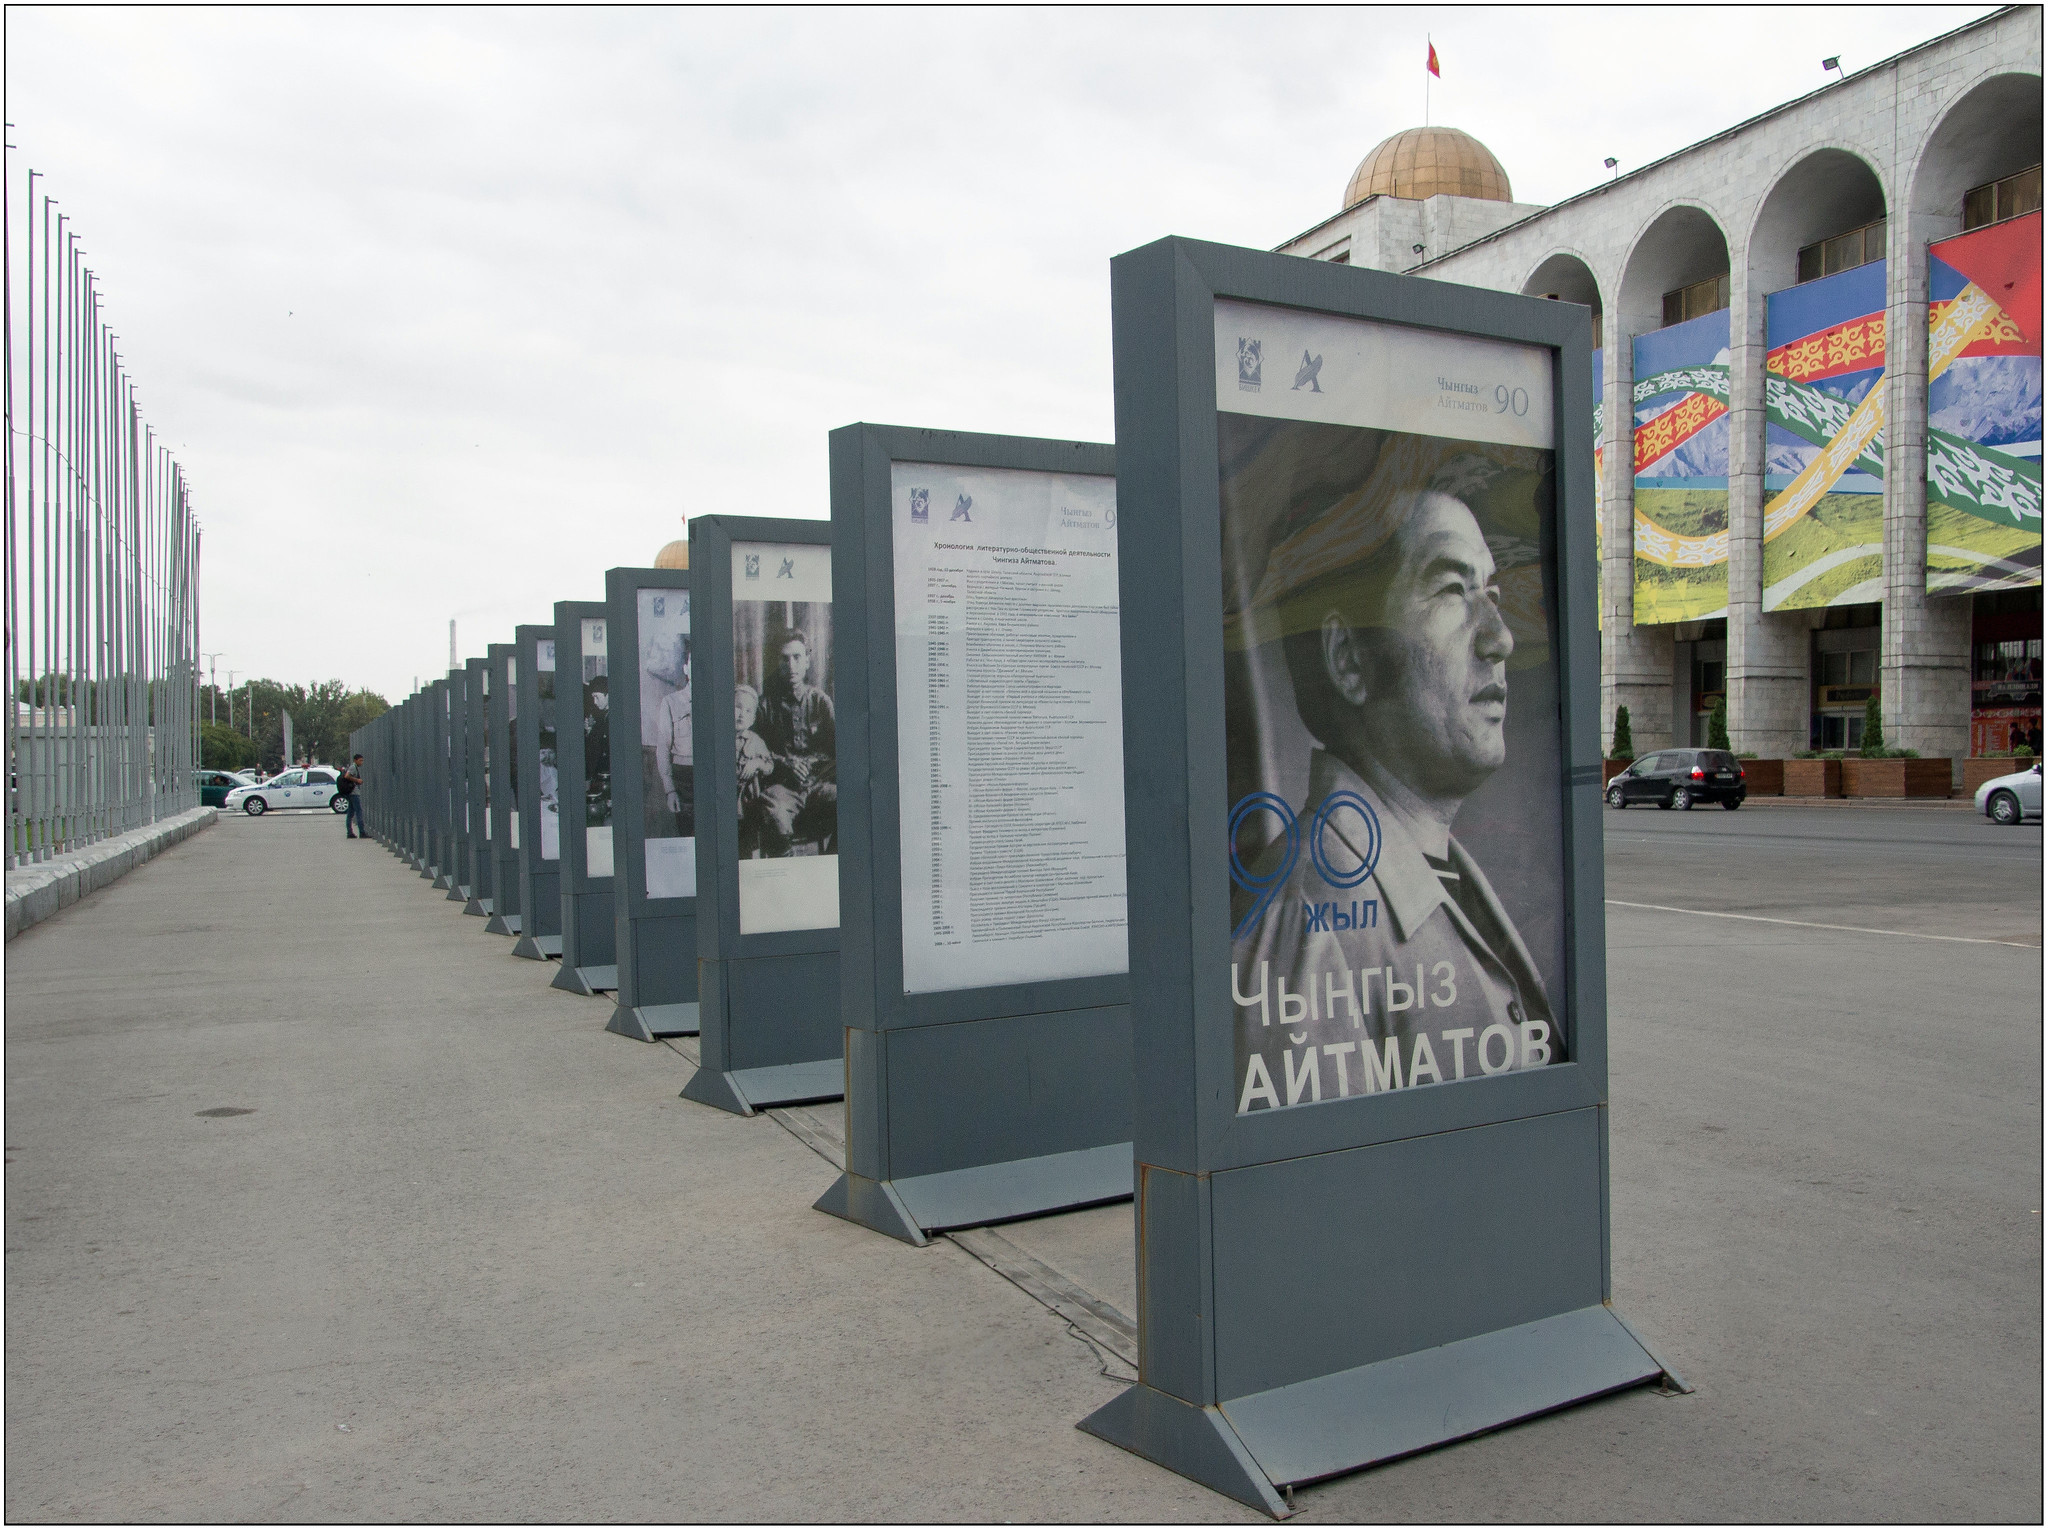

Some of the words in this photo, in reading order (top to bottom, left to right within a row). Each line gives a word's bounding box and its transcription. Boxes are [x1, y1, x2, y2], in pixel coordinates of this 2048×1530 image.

[1437, 395, 1488, 413] Айтматов
[1495, 384, 1529, 417] 90
[934, 542, 974, 552] Хронология
[977, 545, 1067, 557] литературно-общественной
[1069, 549, 1111, 558] деятельности
[993, 556, 1019, 565] Чингиза
[1228, 790, 1382, 941] 90
[1237, 1020, 1552, 1114] АЙТМАТОВ
